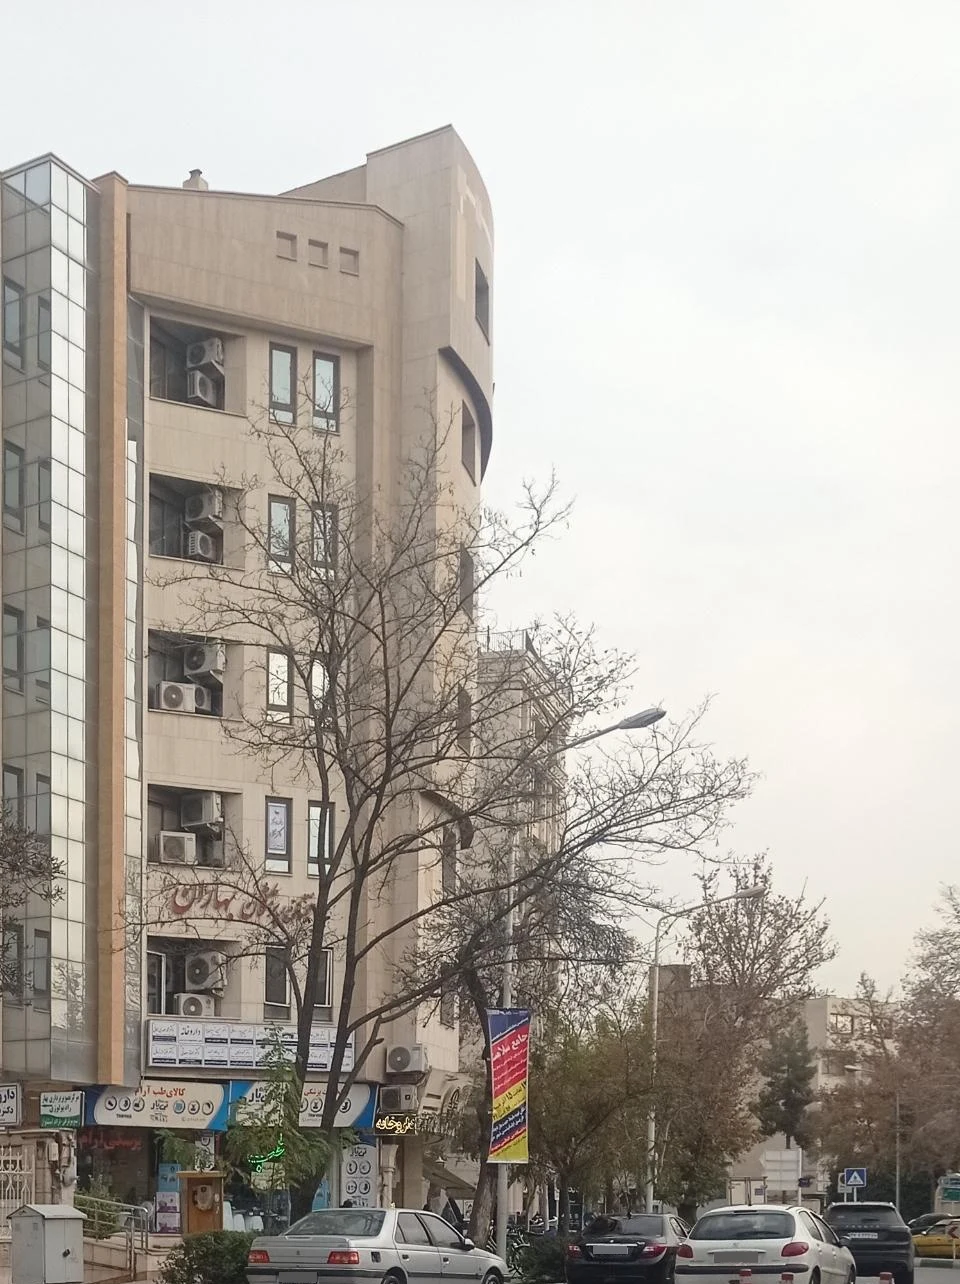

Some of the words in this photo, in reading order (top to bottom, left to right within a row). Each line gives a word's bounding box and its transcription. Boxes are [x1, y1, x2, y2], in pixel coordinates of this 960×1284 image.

[135, 1086, 150, 1098] آرام
[166, 1088, 186, 1098] کالای
[1, 1106, 14, 1117] دکتر
